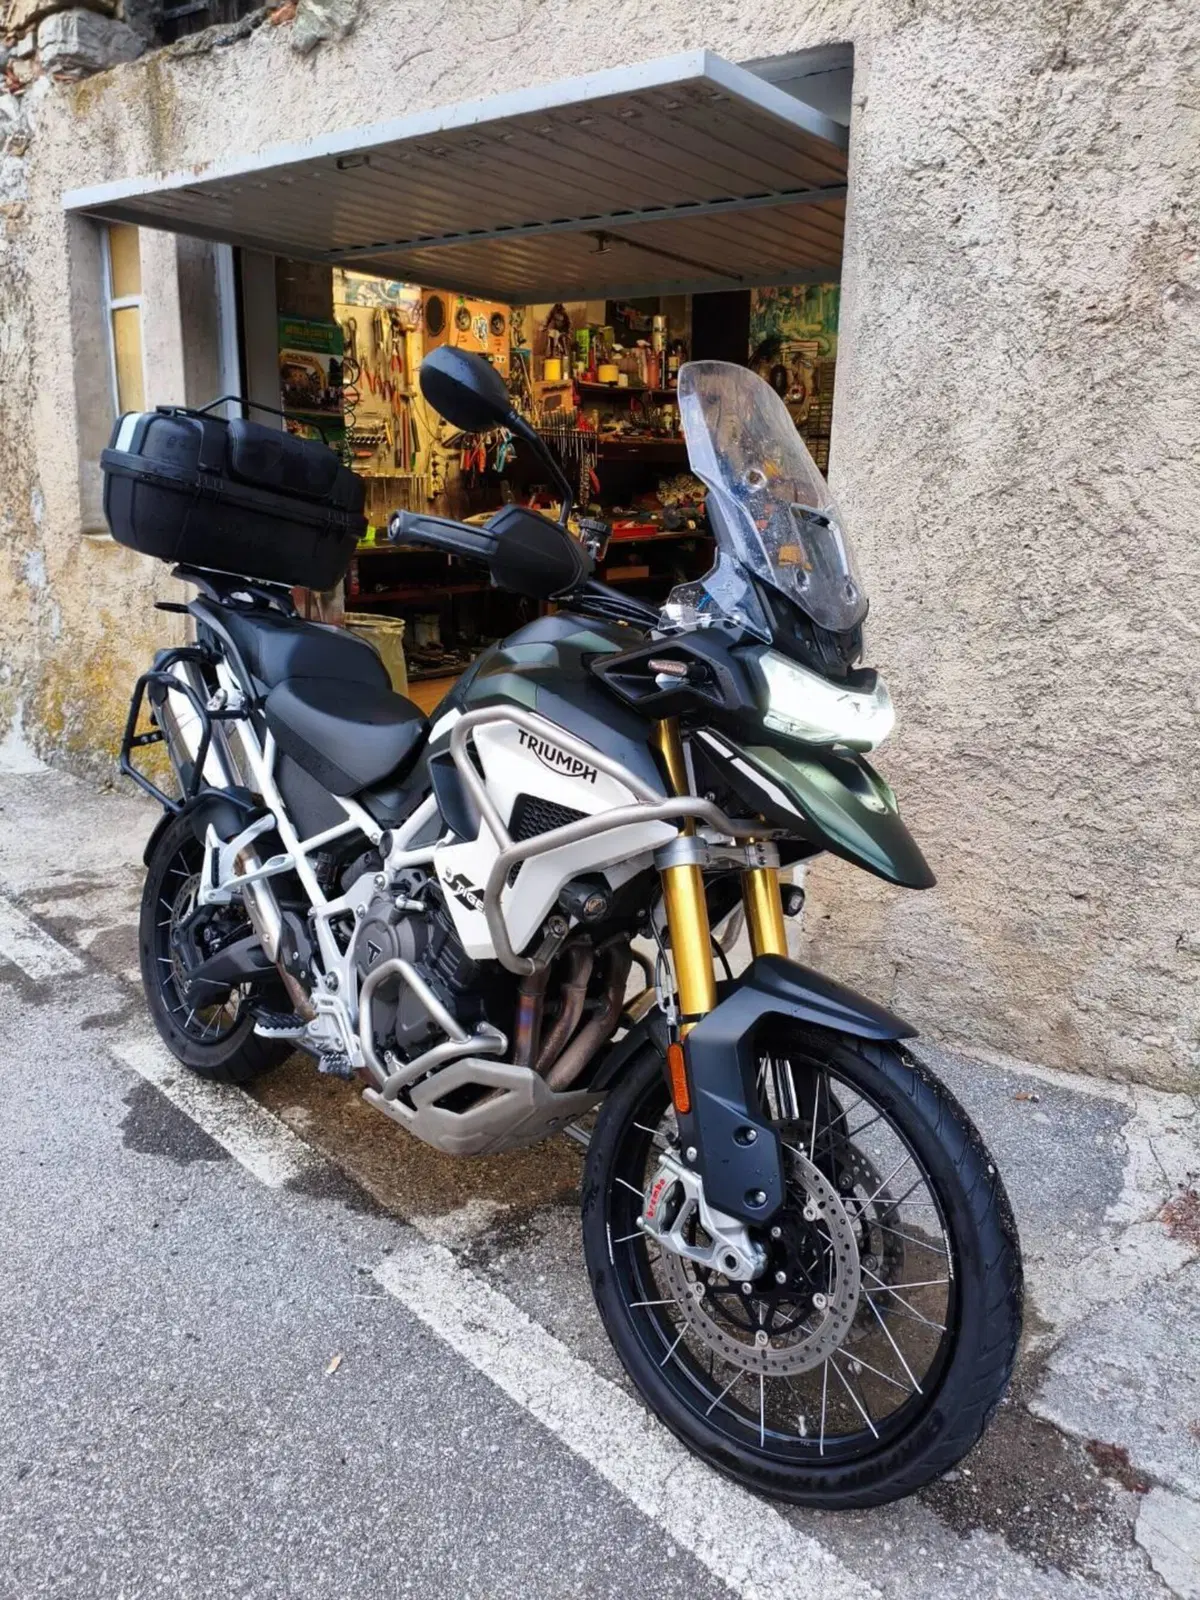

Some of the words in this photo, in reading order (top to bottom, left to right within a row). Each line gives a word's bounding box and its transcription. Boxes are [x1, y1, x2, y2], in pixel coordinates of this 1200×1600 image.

[518, 728, 598, 784] TRIUMPH
[454, 879, 487, 916] TIGE
[647, 1179, 665, 1218] brembo
